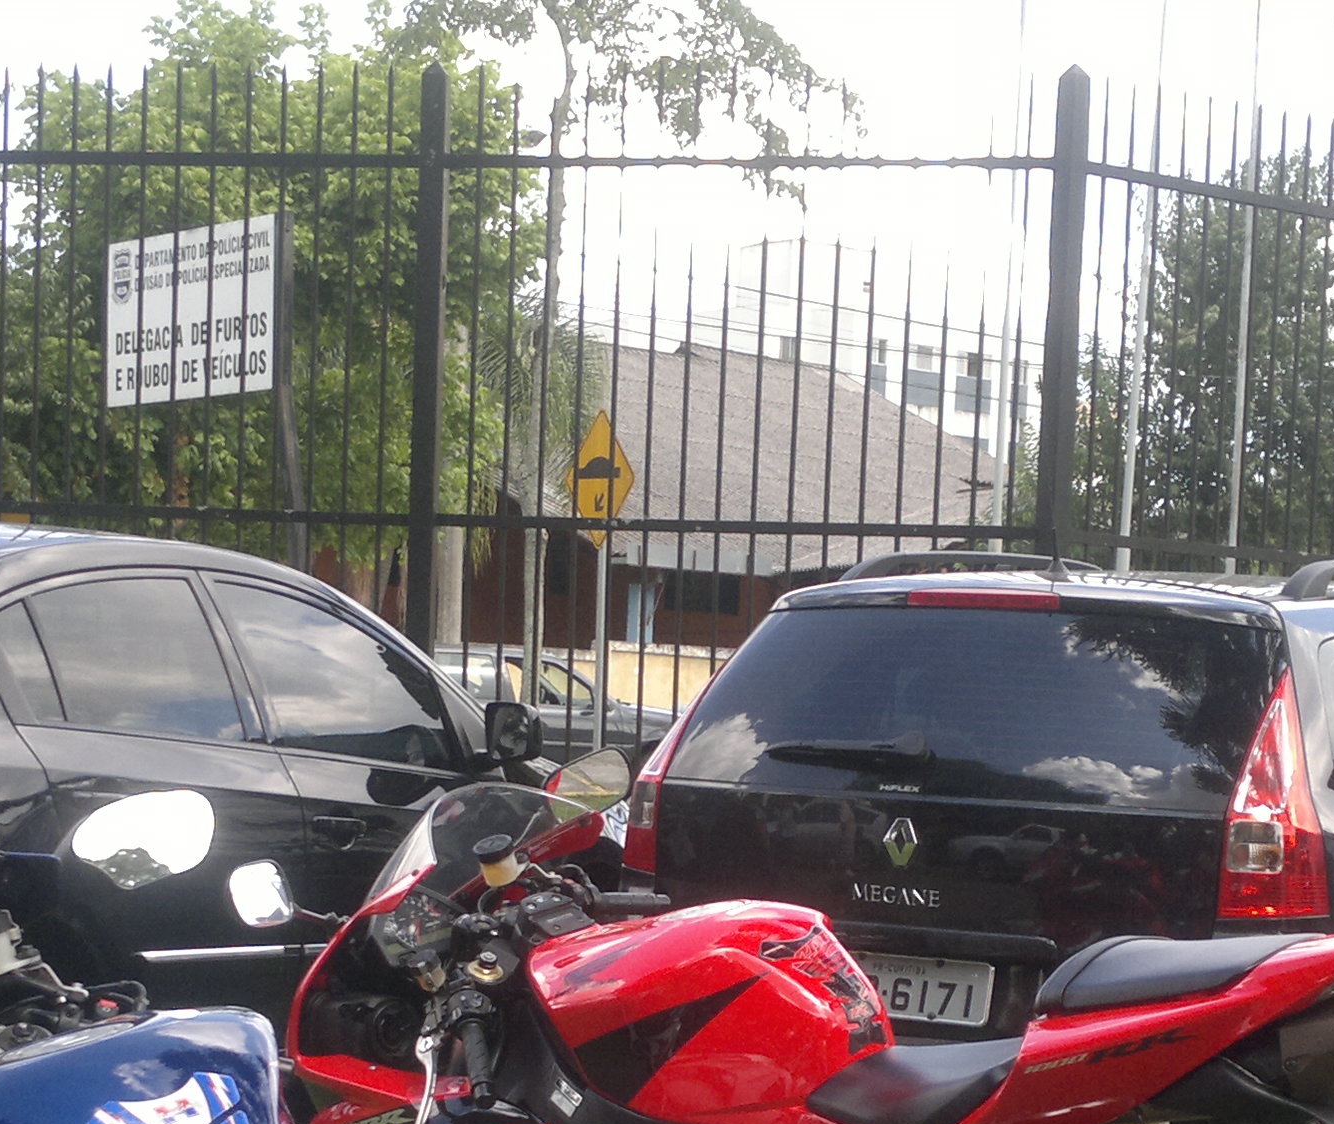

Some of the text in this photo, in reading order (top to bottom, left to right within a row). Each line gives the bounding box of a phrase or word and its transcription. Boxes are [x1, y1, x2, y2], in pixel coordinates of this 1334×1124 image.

[135, 244, 196, 269] DPARTAMNTO
[135, 271, 163, 292] DVISÃO
[210, 255, 270, 279] SPECIAZADA
[116, 312, 267, 355] DELEGACA DE FUROS
[116, 349, 266, 391] E RUBO DE VEÍCUOS
[852, 883, 940, 908] MEGANE
